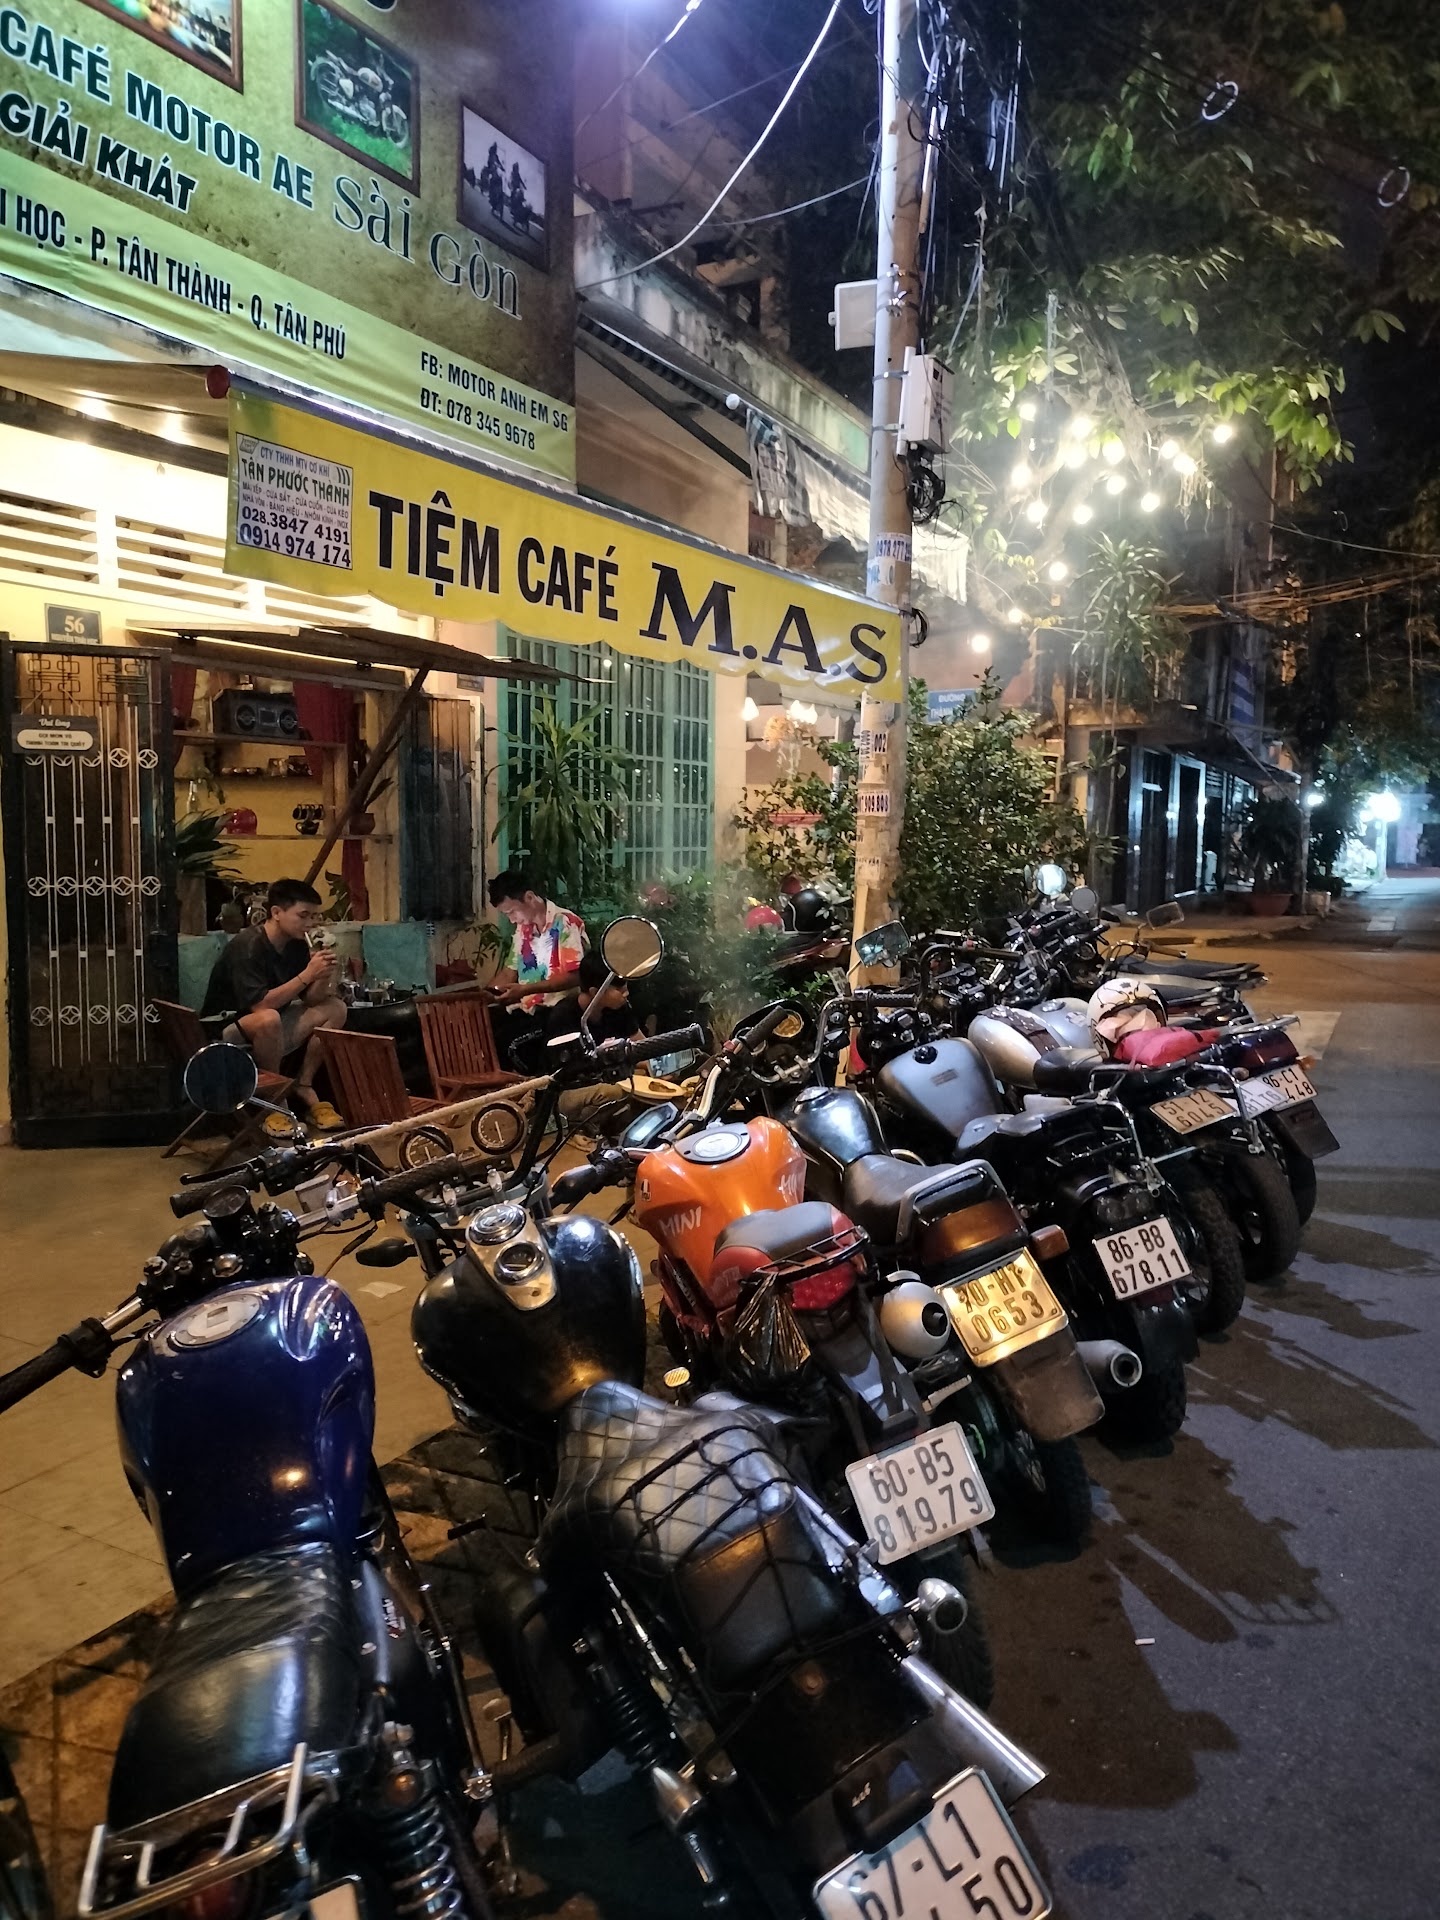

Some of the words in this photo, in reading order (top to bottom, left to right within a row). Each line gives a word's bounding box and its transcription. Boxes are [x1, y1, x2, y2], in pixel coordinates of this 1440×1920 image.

[0, 93, 89, 165] GIẢI
[94, 133, 198, 213] KHÁT
[0, 10, 111, 103] CAFÉ
[126, 71, 261, 182] MOTOR
[273, 154, 314, 208] AE
[333, 174, 416, 264] Sài
[429, 231, 522, 321] Gòn
[16, 195, 66, 249] HỌC
[91, 225, 108, 267] P.
[116, 236, 158, 286] TÂN
[165, 257, 232, 314] THÀNH
[251, 294, 267, 332] Q.
[273, 303, 307, 345] TÂN
[312, 321, 346, 360] PHÚ
[421, 350, 443, 379] FB:
[448, 363, 496, 401] MOTOR
[500, 387, 526, 415] ANH
[530, 400, 549, 424] EM
[552, 409, 568, 432] SG
[420, 387, 442, 415] ĐT:
[446, 400, 472, 426] 078
[476, 410, 500, 437] 345
[505, 422, 535, 451] 9678
[241, 456, 264, 483] TÂN
[268, 464, 309, 494] PHƯỚC
[312, 479, 350, 507] THÀNH
[260, 446, 274, 461] CTY
[296, 455, 307, 471] MTV
[240, 523, 281, 552] 0914
[285, 535, 316, 560] 974
[322, 544, 351, 568] 174
[241, 505, 309, 535] 028.3847
[314, 523, 350, 546] 4191
[368, 489, 500, 597] TIỆM
[516, 537, 620, 623] CAFÉ
[63, 614, 85, 635] 56
[1176, 1102, 1225, 1128] 6045
[658, 1205, 702, 1238] MINI
[1107, 1224, 1165, 1263] 86-B8
[1111, 1248, 1185, 1294] 678.11
[970, 1290, 1044, 1343] 0653
[869, 1437, 955, 1504] 60-B5
[874, 1476, 983, 1553] 819.79
[847, 1800, 981, 1920] 67-L1
